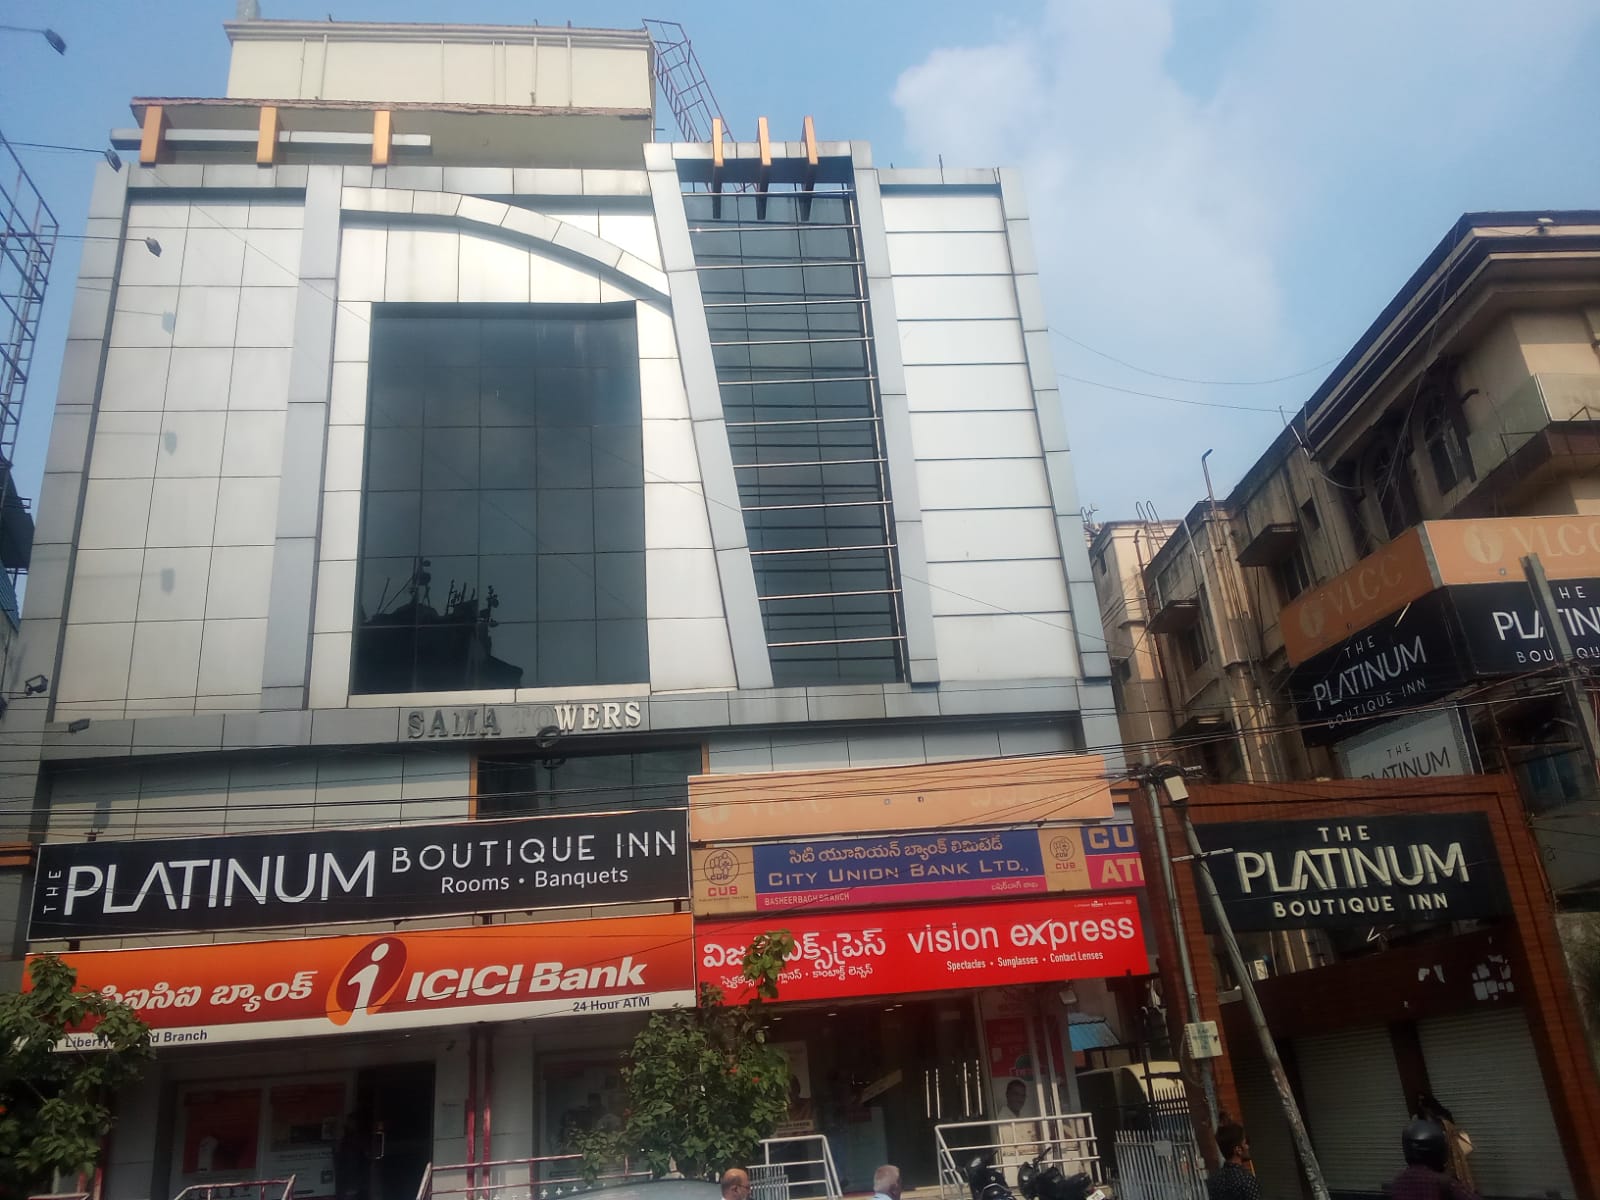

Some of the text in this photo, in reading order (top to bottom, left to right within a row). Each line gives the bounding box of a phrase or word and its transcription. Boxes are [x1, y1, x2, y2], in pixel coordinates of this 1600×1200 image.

[1558, 585, 1587, 599] HE
[1344, 635, 1376, 659] THE
[1313, 635, 1427, 711] PLATINUM
[1327, 678, 1427, 729] BOUTIQUE INN
[1386, 742, 1412, 759] THE
[1317, 825, 1371, 843] THE
[391, 830, 676, 873] BOUTIQUE INN
[904, 838, 948, 861] బ్యాంక్
[768, 871, 818, 887] CITY
[828, 866, 899, 883] UNION
[910, 862, 970, 877] BANK
[1234, 842, 1470, 893] PLATINUM
[43, 870, 62, 914] THE
[64, 850, 376, 916] PLATINUM
[441, 867, 629, 894] Rooms Banquets
[708, 886, 738, 897] CUB
[764, 894, 817, 906] BASHEERBAGH
[1272, 893, 1449, 918] BOUTIQUE INN
[907, 917, 1135, 954] vision express
[703, 943, 747, 968] విజ
[946, 951, 1104, 973] Spectacles Sunglasses Contact Lenses
[209, 970, 319, 1013] బ్యాంక్
[405, 956, 648, 1003] ICICI Bank
[572, 996, 650, 1013] 24 Hour ATM
[163, 1030, 208, 1043] Branch
